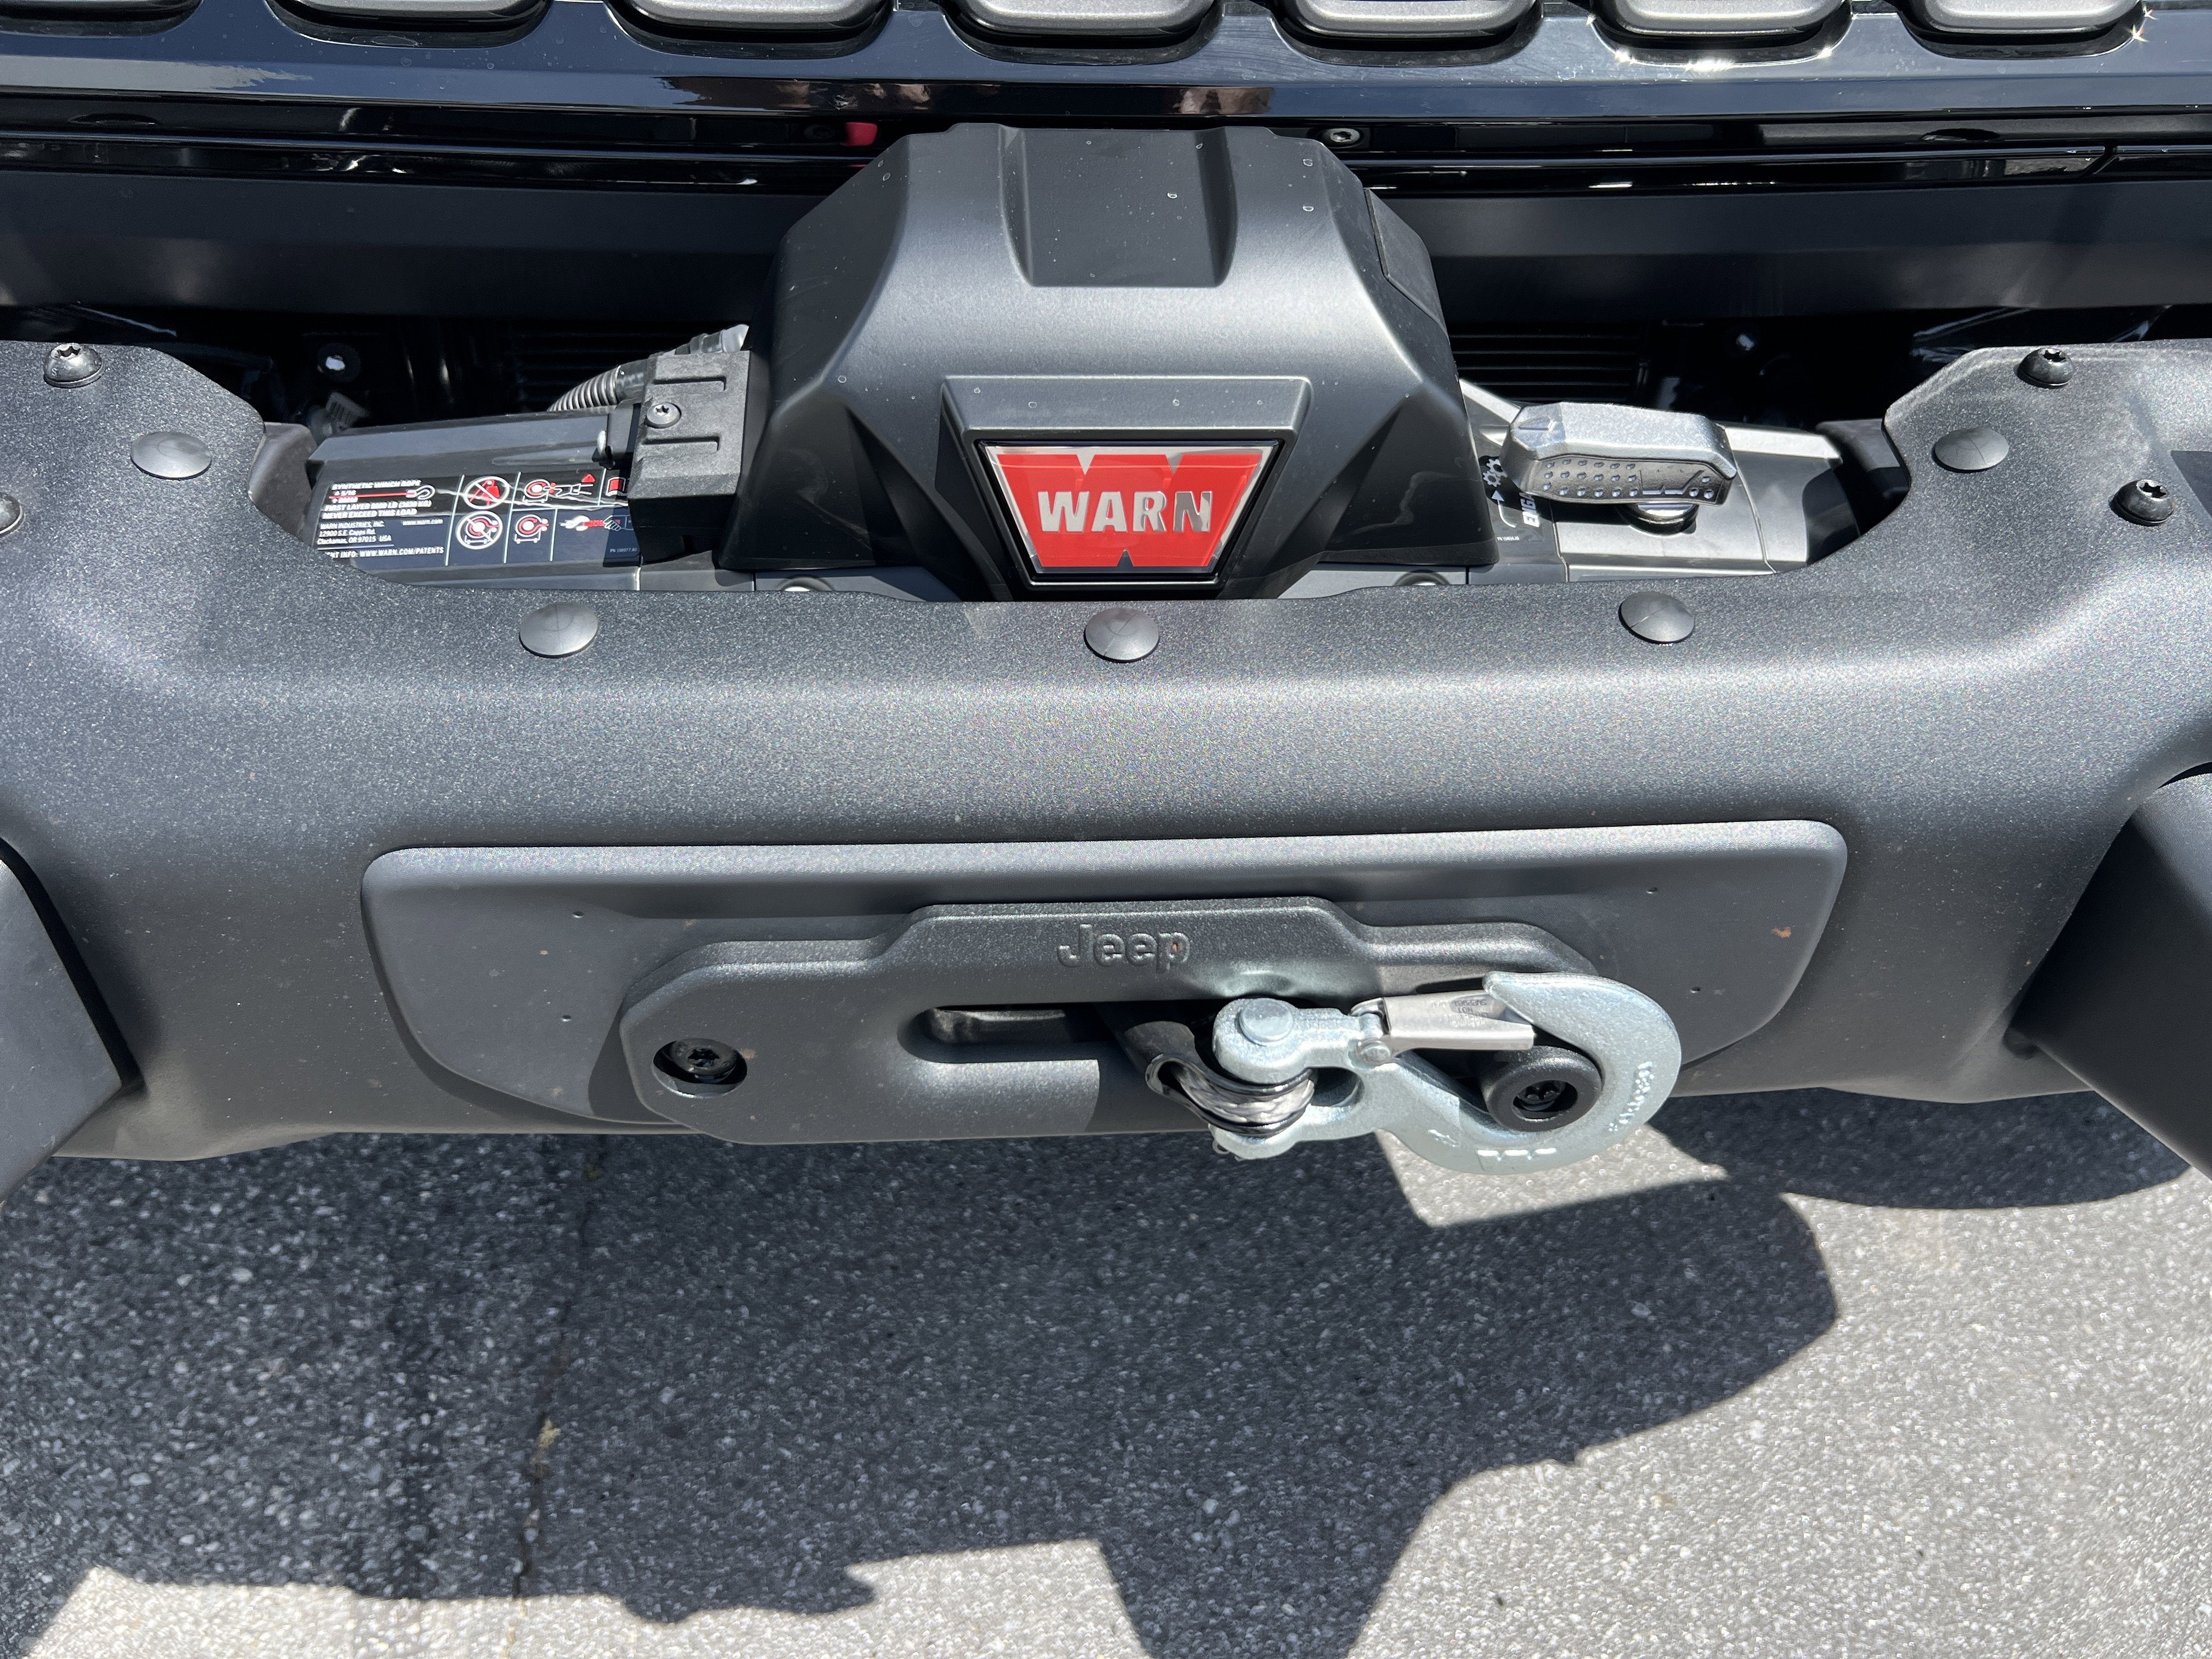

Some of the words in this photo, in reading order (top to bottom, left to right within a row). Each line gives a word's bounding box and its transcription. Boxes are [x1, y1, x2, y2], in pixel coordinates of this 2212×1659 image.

[331, 481, 374, 490] SYNTHETIC
[374, 480, 400, 488] WINCH
[346, 503, 370, 511] LAYER
[1037, 491, 1212, 533] WARN
[340, 550, 358, 558] INFO:
[360, 546, 444, 557] WWW.WARN.COM/PATENTS
[1057, 924, 1190, 974] Jeep
